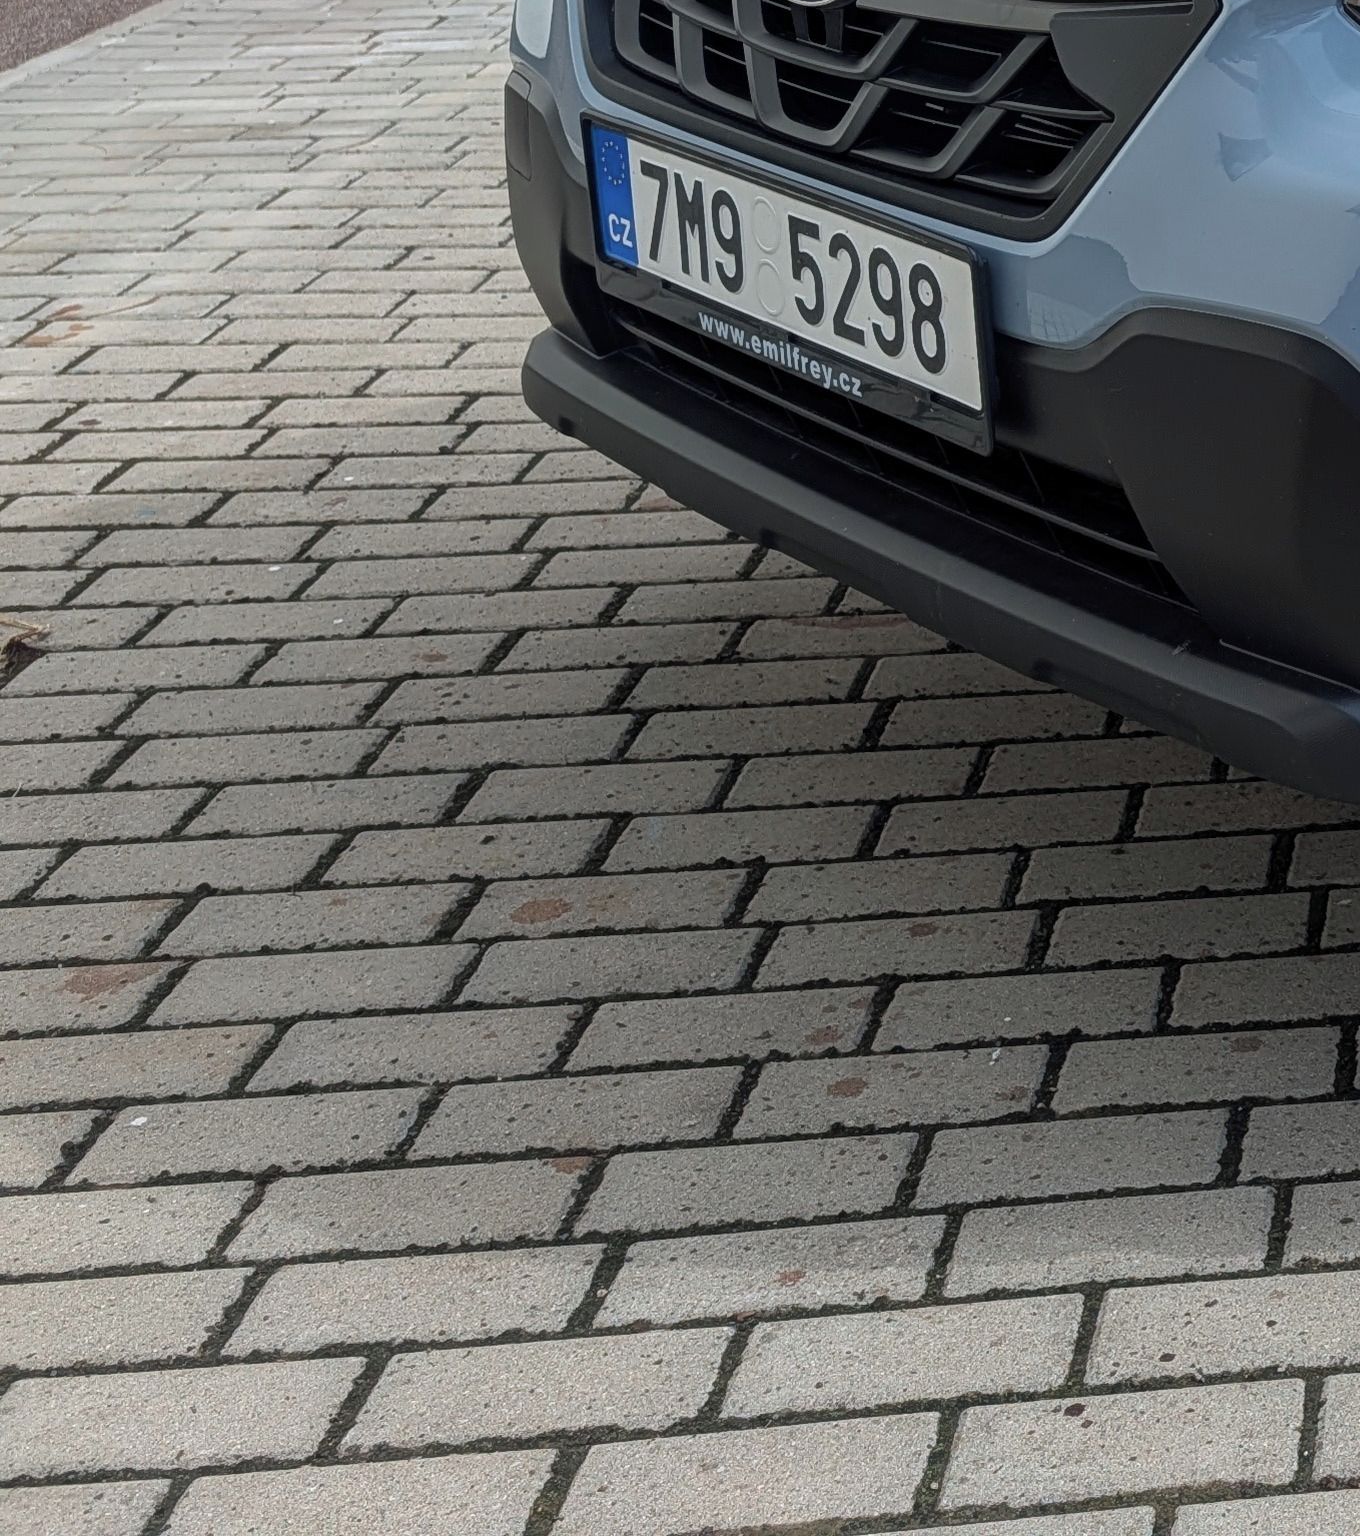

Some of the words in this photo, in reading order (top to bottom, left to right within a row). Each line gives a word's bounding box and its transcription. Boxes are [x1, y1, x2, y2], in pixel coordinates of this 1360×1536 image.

[608, 213, 633, 248] CZ
[640, 159, 745, 294] 7M9
[787, 213, 946, 375] 5298
[698, 312, 863, 398] www.emilfrey.cz
